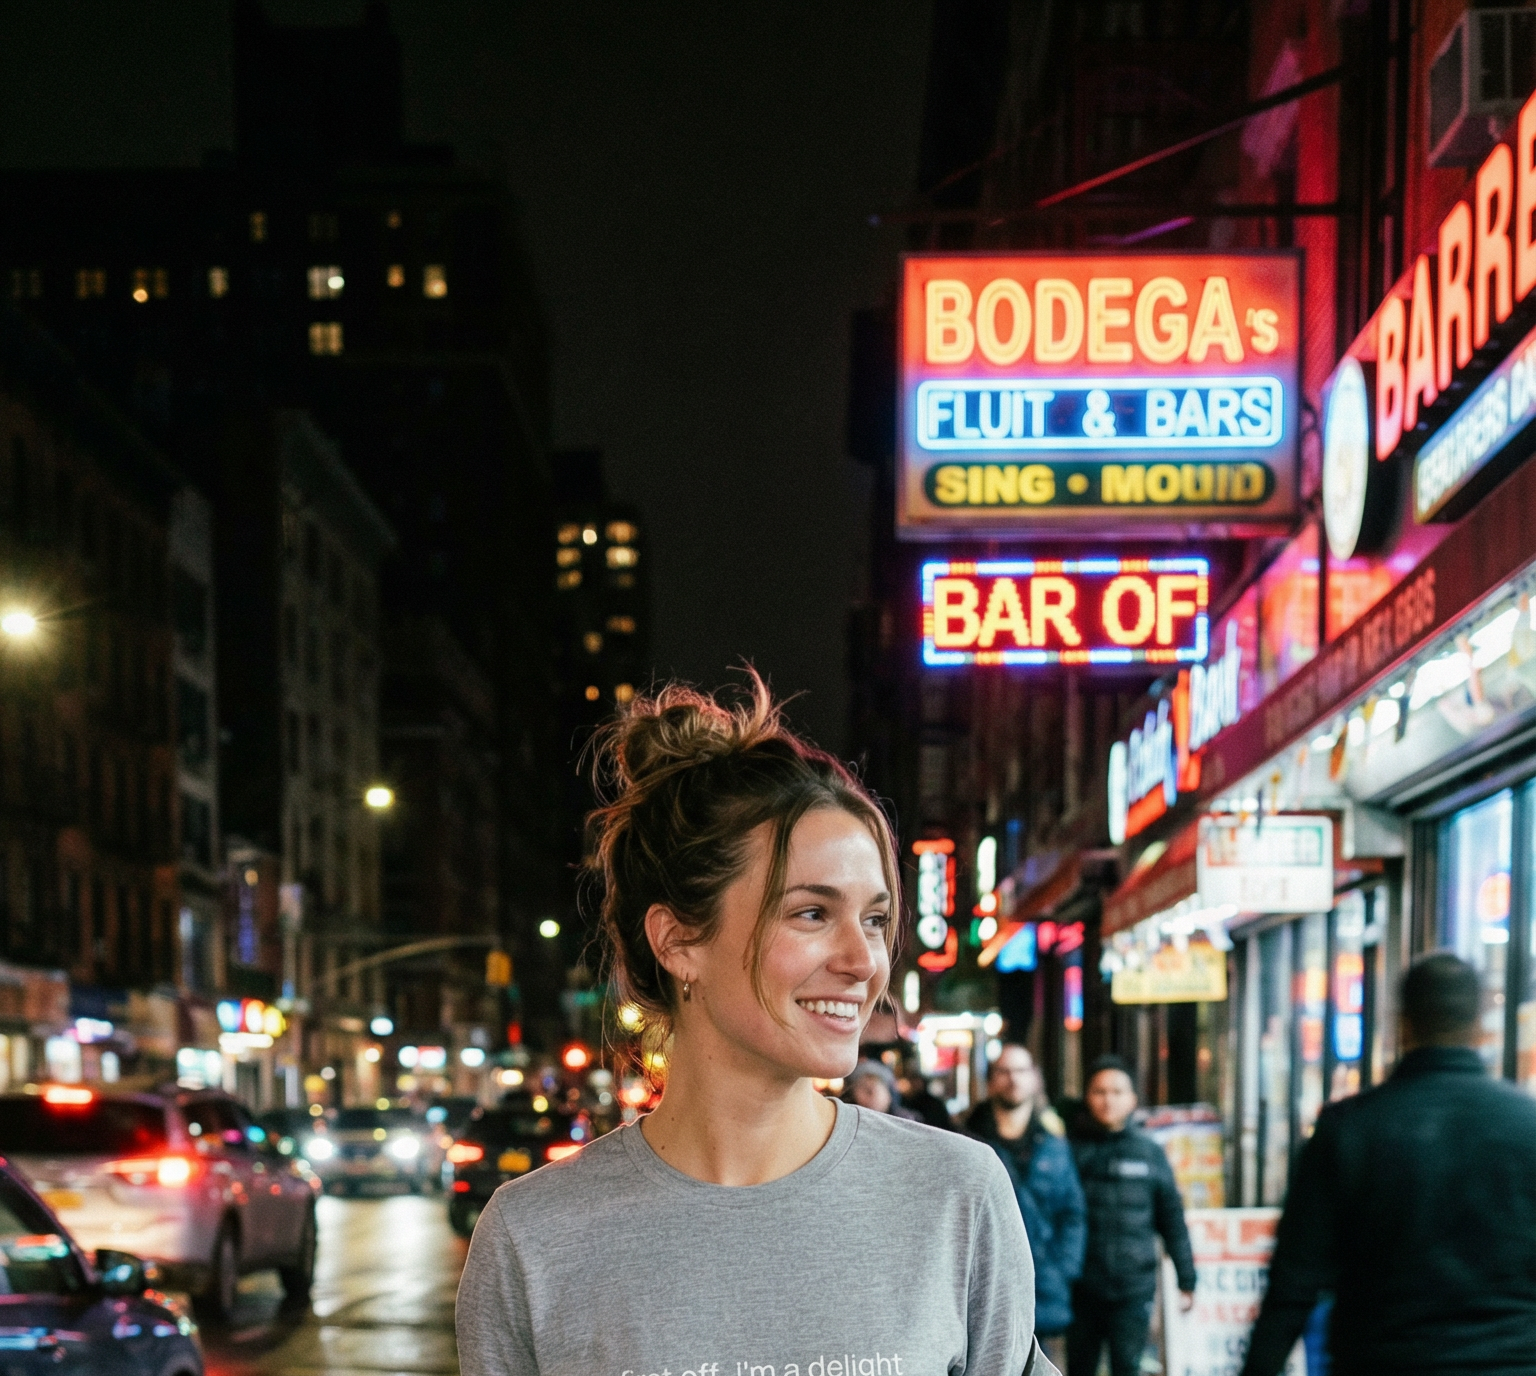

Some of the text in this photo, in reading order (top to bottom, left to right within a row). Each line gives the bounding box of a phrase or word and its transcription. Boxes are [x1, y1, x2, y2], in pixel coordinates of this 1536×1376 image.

[927, 387, 1272, 439] FLUIT & BARS
[935, 464, 1056, 504] SING
[933, 575, 1199, 648] BAR OF
